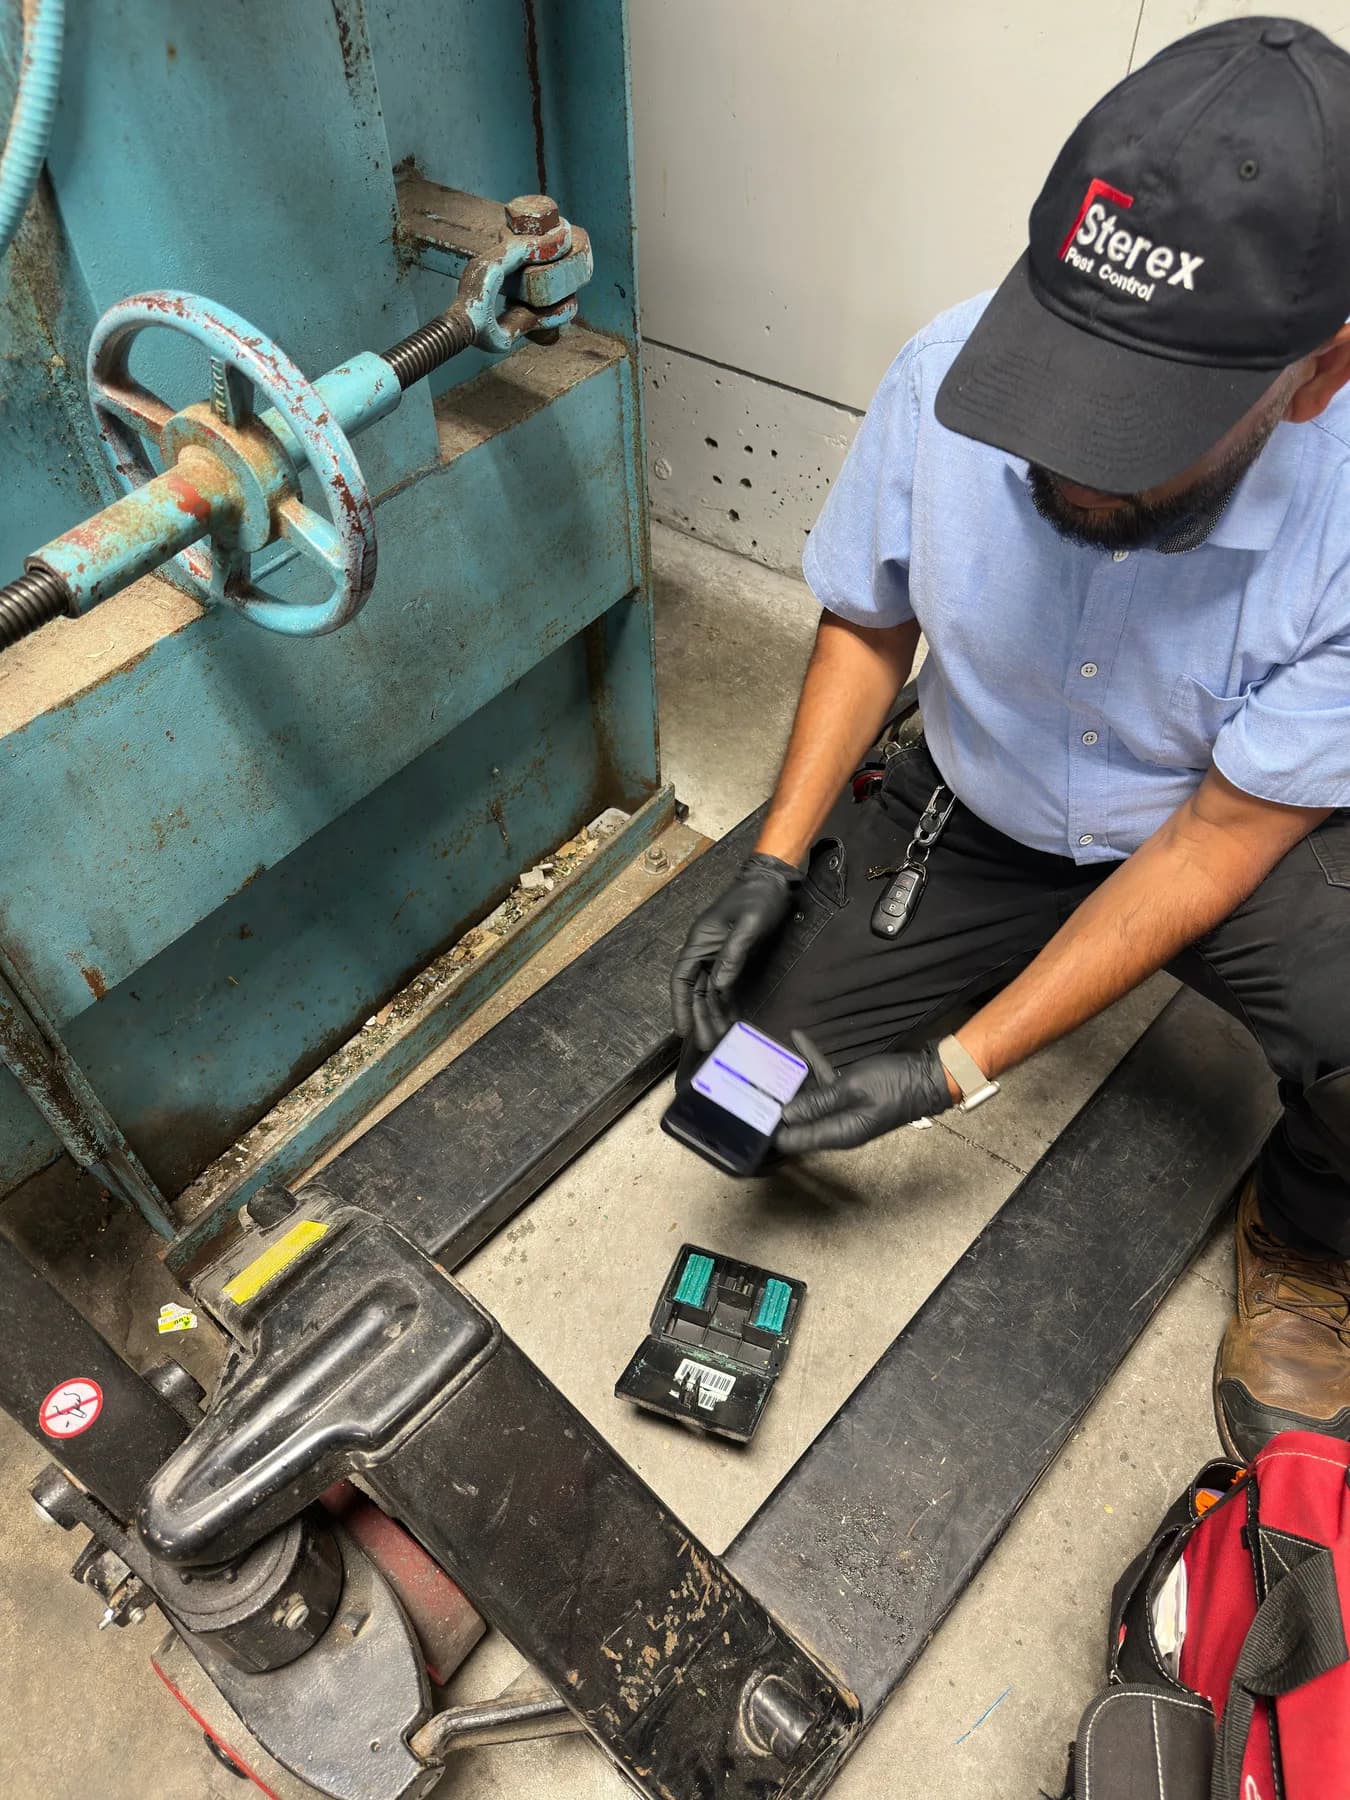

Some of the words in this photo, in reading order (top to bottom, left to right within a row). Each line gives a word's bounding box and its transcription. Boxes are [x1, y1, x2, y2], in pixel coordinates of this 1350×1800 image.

[1065, 247, 1094, 273] Pest
[1098, 264, 1155, 302] Control
[1077, 203, 1204, 290] Sterex
